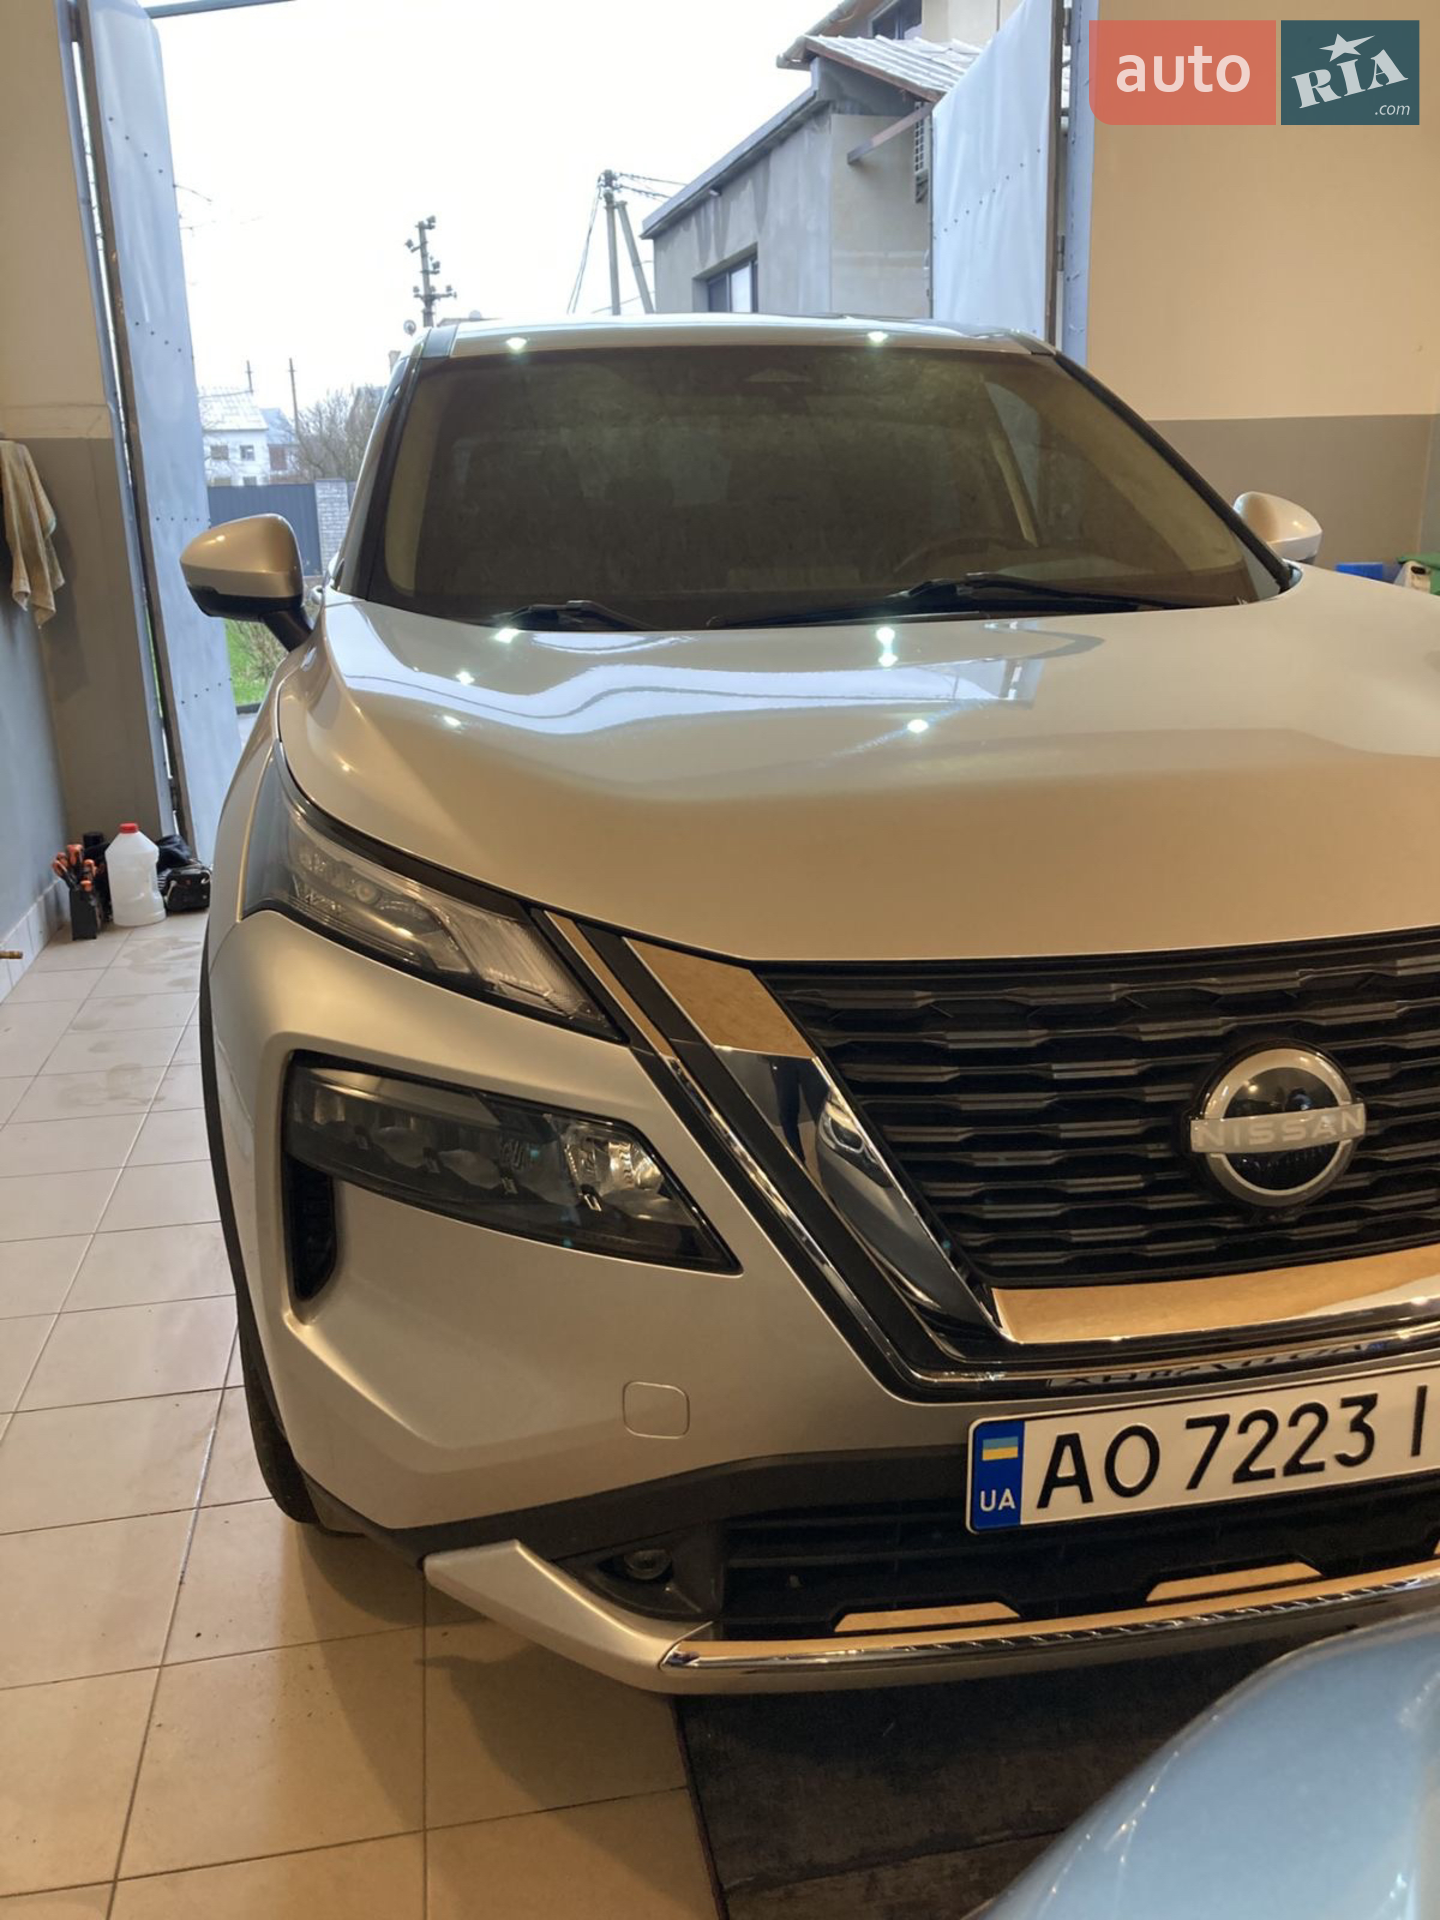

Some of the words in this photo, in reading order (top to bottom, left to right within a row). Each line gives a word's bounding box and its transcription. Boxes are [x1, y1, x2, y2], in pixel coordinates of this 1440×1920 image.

[1199, 1107, 1364, 1147] NISSAN
[1036, 1424, 1160, 1509] AO
[1185, 1393, 1378, 1491] 7223
[980, 1490, 1016, 1512] UA
